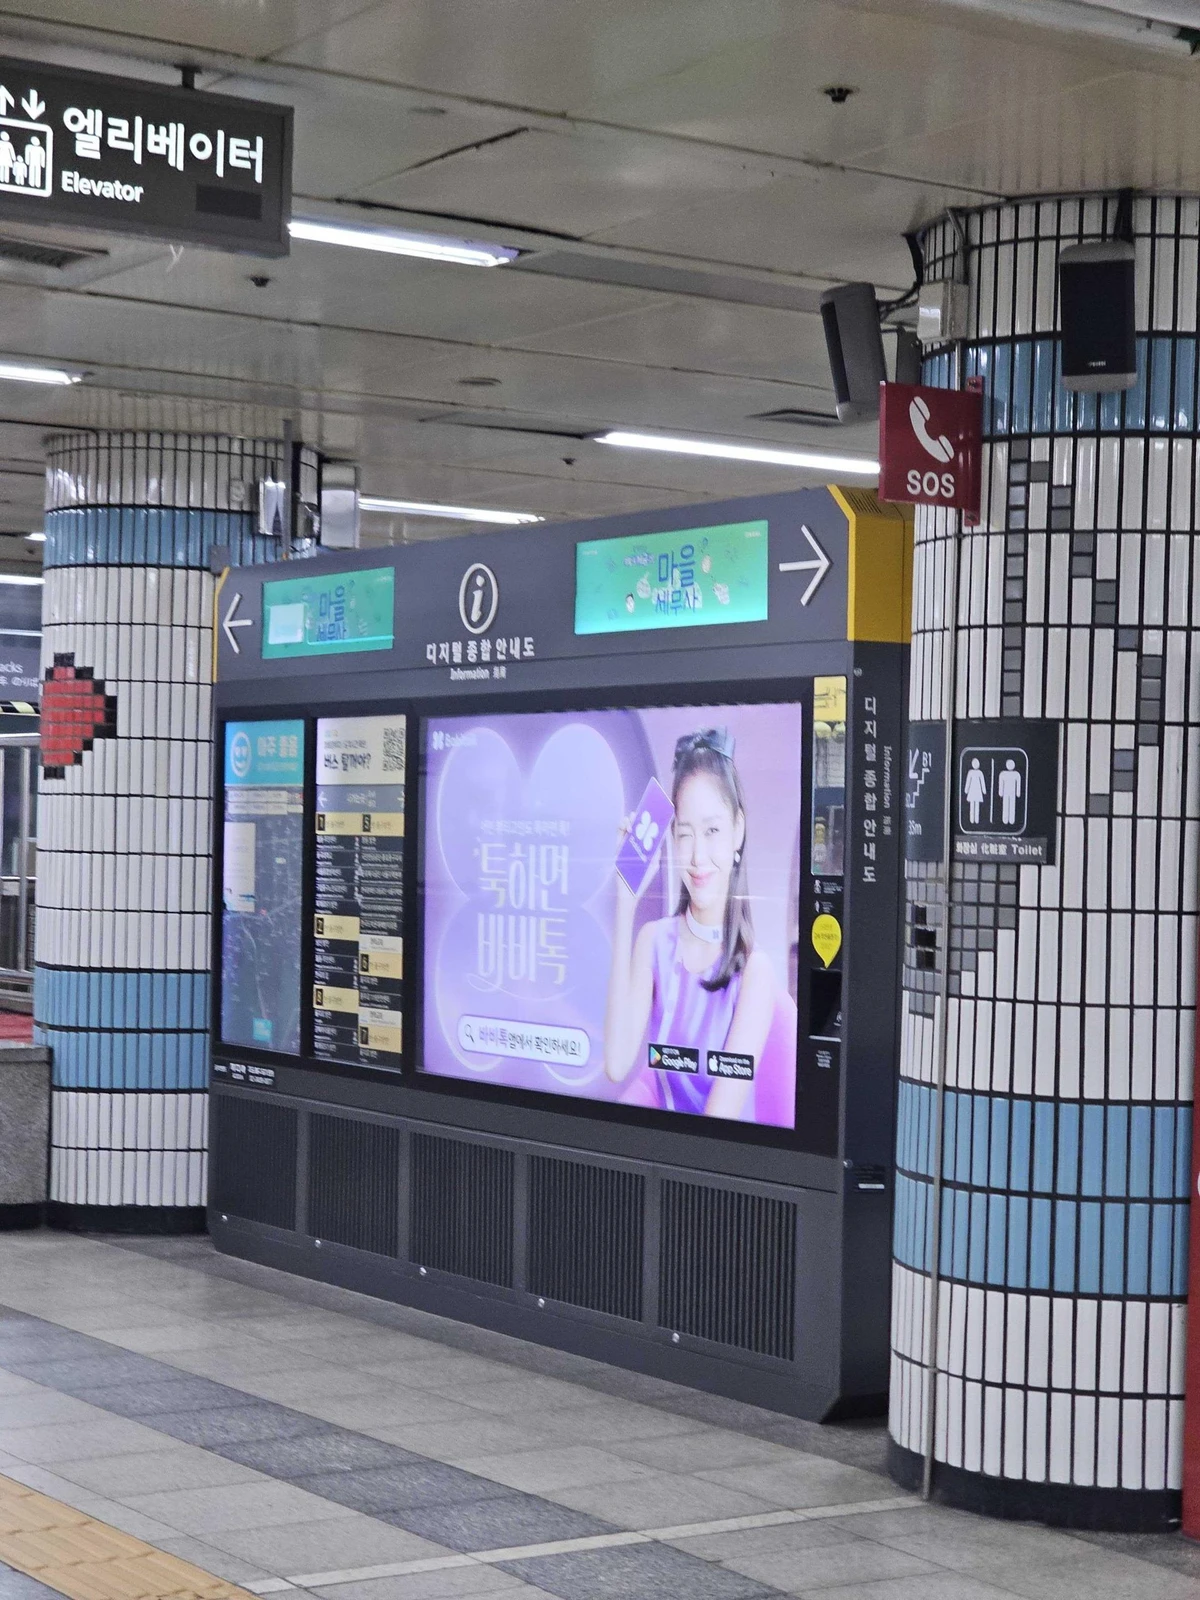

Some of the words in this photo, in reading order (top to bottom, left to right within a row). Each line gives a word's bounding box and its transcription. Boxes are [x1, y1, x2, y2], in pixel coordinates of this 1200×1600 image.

[62, 107, 263, 183] 엘리베이터
[61, 170, 144, 202] Elevator
[906, 470, 955, 498] SOS
[659, 544, 695, 587] 마을
[655, 588, 698, 616] 세무사
[426, 641, 463, 665] 디지털
[466, 639, 492, 663] 종합
[495, 637, 535, 660] 안내도
[864, 696, 877, 762] 디지털
[883, 745, 892, 809] Information
[922, 751, 932, 767] B1
[864, 769, 877, 812] 종합
[863, 818, 877, 883] 안내도
[956, 841, 977, 855] 화장실
[1011, 843, 1042, 856] Toilet
[478, 842, 570, 912] 톡하면
[477, 912, 570, 986] 바비톡
[661, 1054, 683, 1070] Google
[683, 1056, 698, 1072] Play
[719, 1062, 733, 1076] App
[733, 1063, 752, 1077] Store
